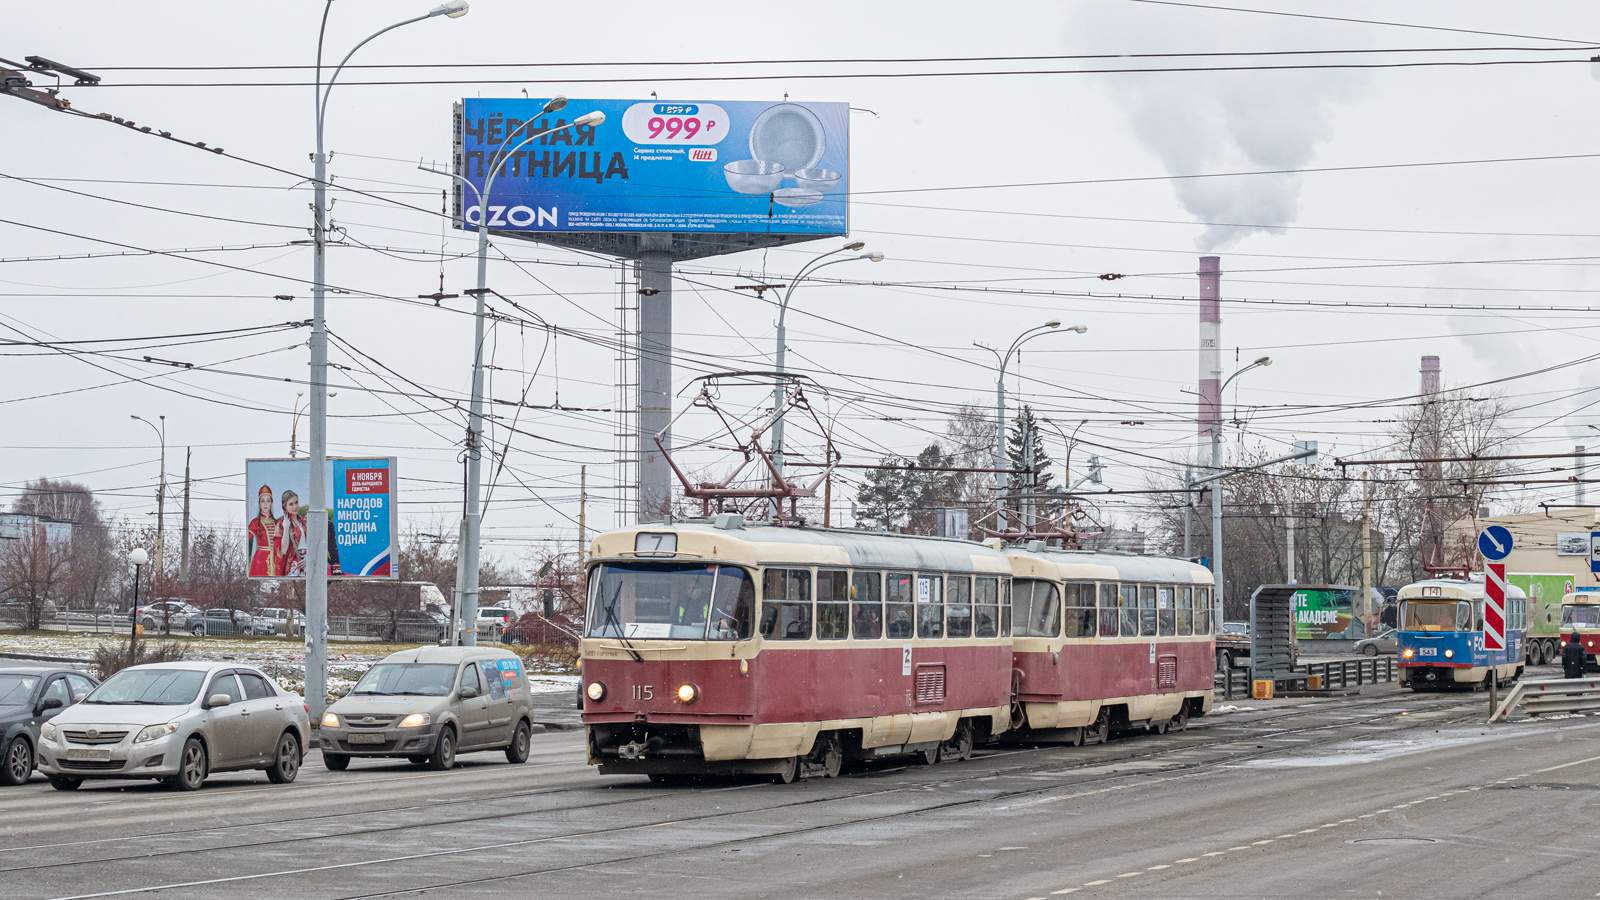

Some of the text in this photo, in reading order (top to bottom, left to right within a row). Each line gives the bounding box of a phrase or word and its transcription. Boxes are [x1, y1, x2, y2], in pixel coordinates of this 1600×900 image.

[465, 112, 595, 146] ЧЁРНАЯ
[648, 117, 701, 139] 999
[692, 150, 713, 160] Hitt
[465, 151, 629, 184] ПЯТНИЦА
[465, 205, 558, 227] OZON
[357, 472, 382, 480] НОЯБРЯ
[337, 498, 383, 510] НАРОДОВ
[337, 510, 370, 520] МНОГО
[338, 522, 377, 534] РОДИНА
[338, 534, 366, 546] ОДНА!
[651, 536, 663, 555] 7
[920, 580, 928, 595] 115
[1429, 587, 1438, 596] 14
[1298, 610, 1338, 625] АКАДЕМЕ
[630, 624, 639, 638] 7
[904, 648, 910, 663] 2
[632, 685, 654, 700] 115
